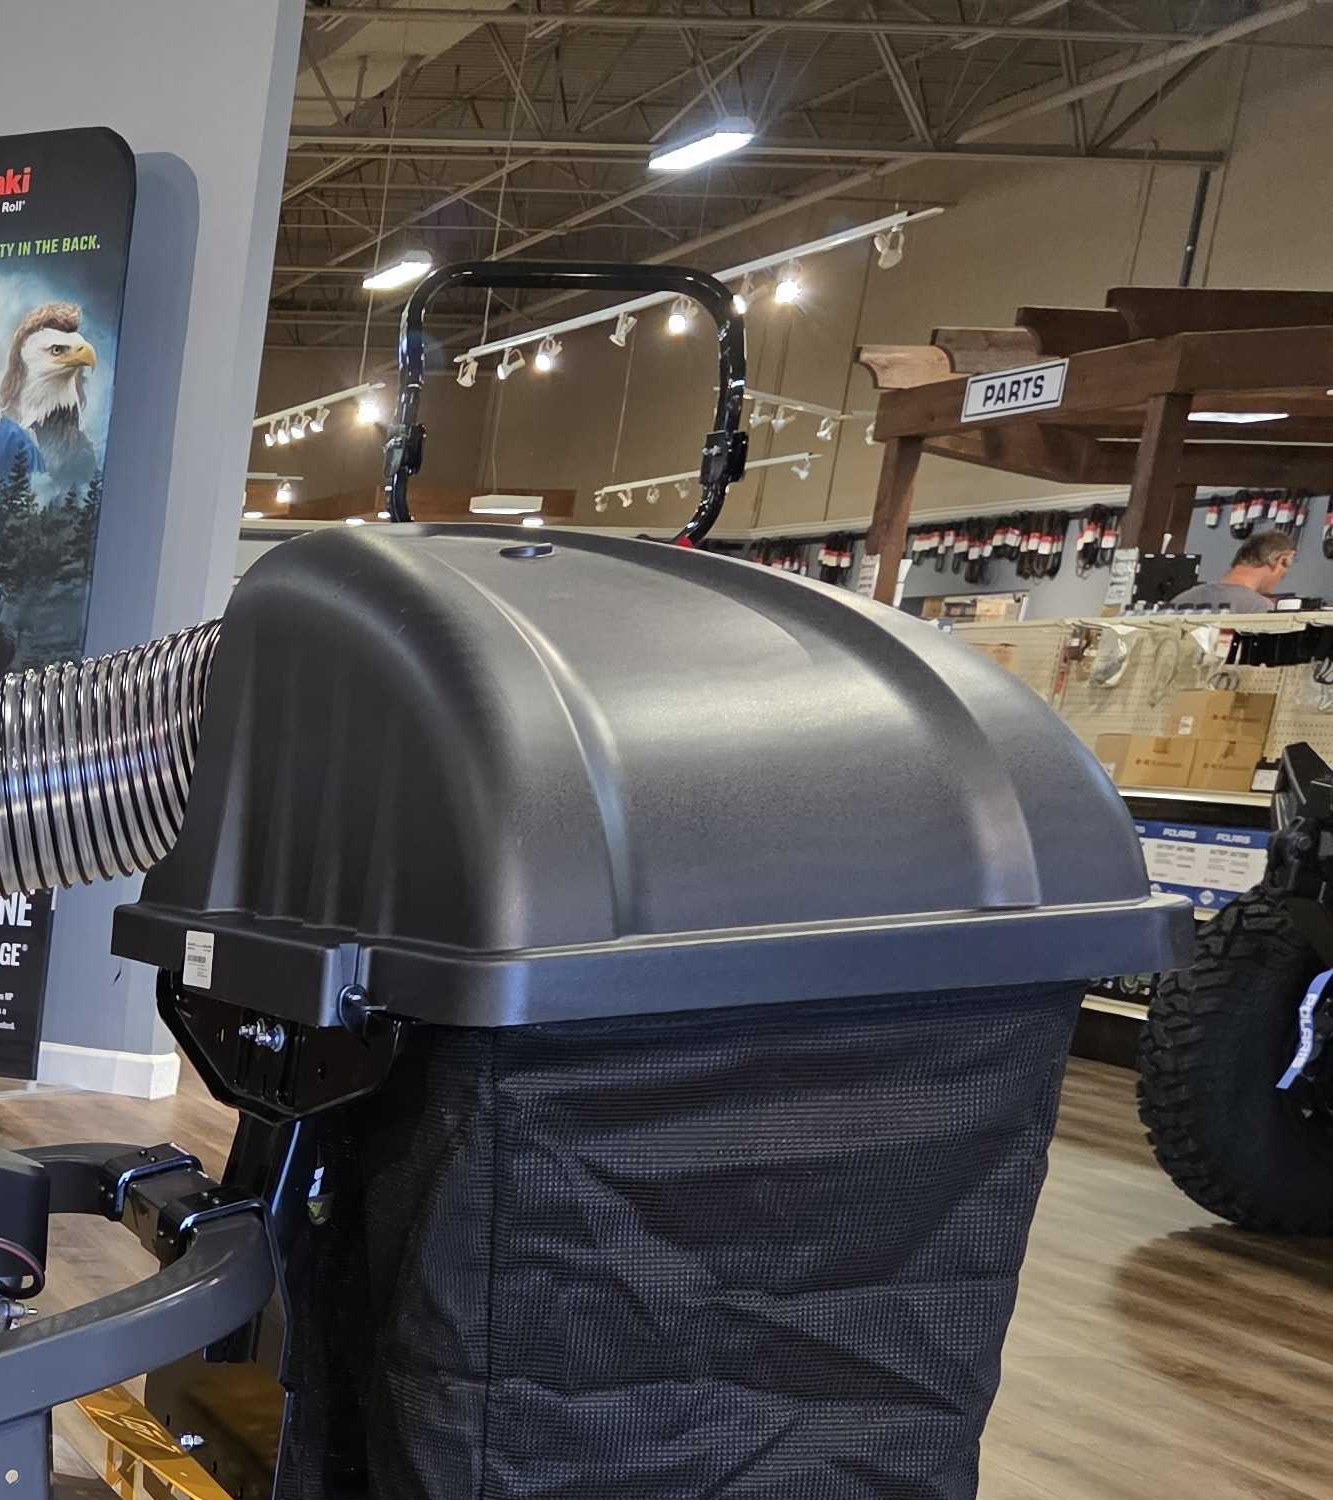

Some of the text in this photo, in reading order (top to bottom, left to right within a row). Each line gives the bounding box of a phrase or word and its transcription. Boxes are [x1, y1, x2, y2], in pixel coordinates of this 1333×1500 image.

[18, 241, 31, 255] IN
[34, 239, 59, 254] THE
[62, 234, 101, 251] BACK.
[982, 375, 1045, 407] PARTS
